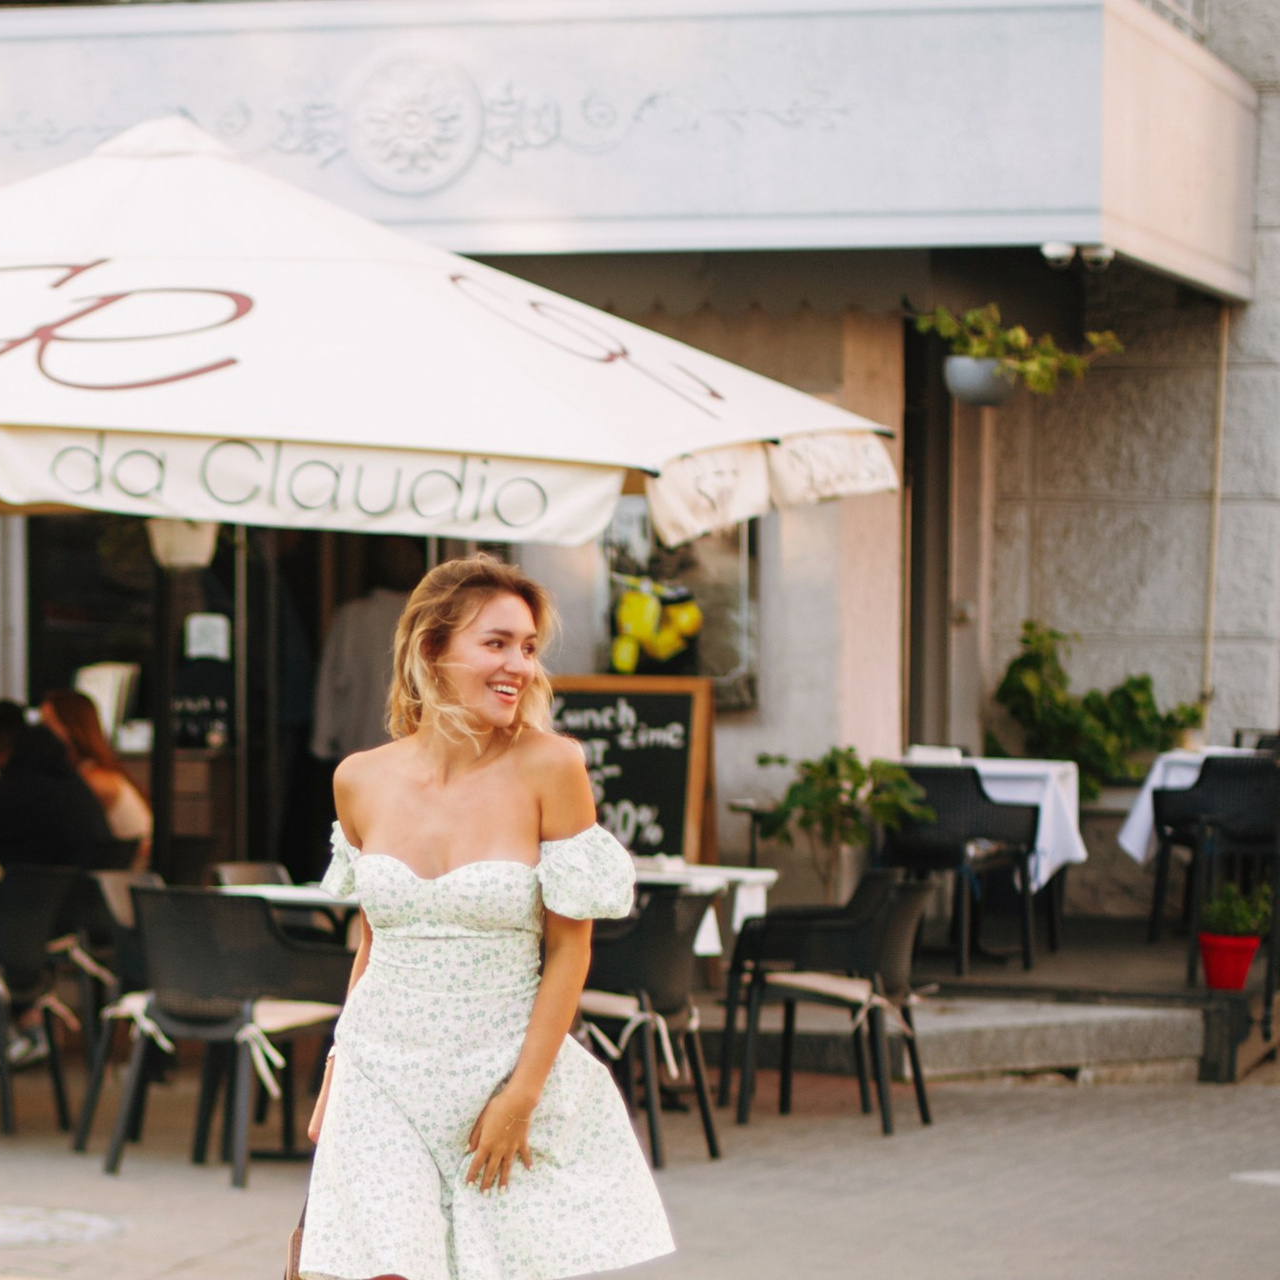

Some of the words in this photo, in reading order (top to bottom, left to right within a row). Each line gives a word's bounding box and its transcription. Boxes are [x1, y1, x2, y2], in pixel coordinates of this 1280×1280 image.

[50, 431, 166, 499] da
[200, 439, 548, 528] Claudio
[551, 697, 637, 730] Lunch
